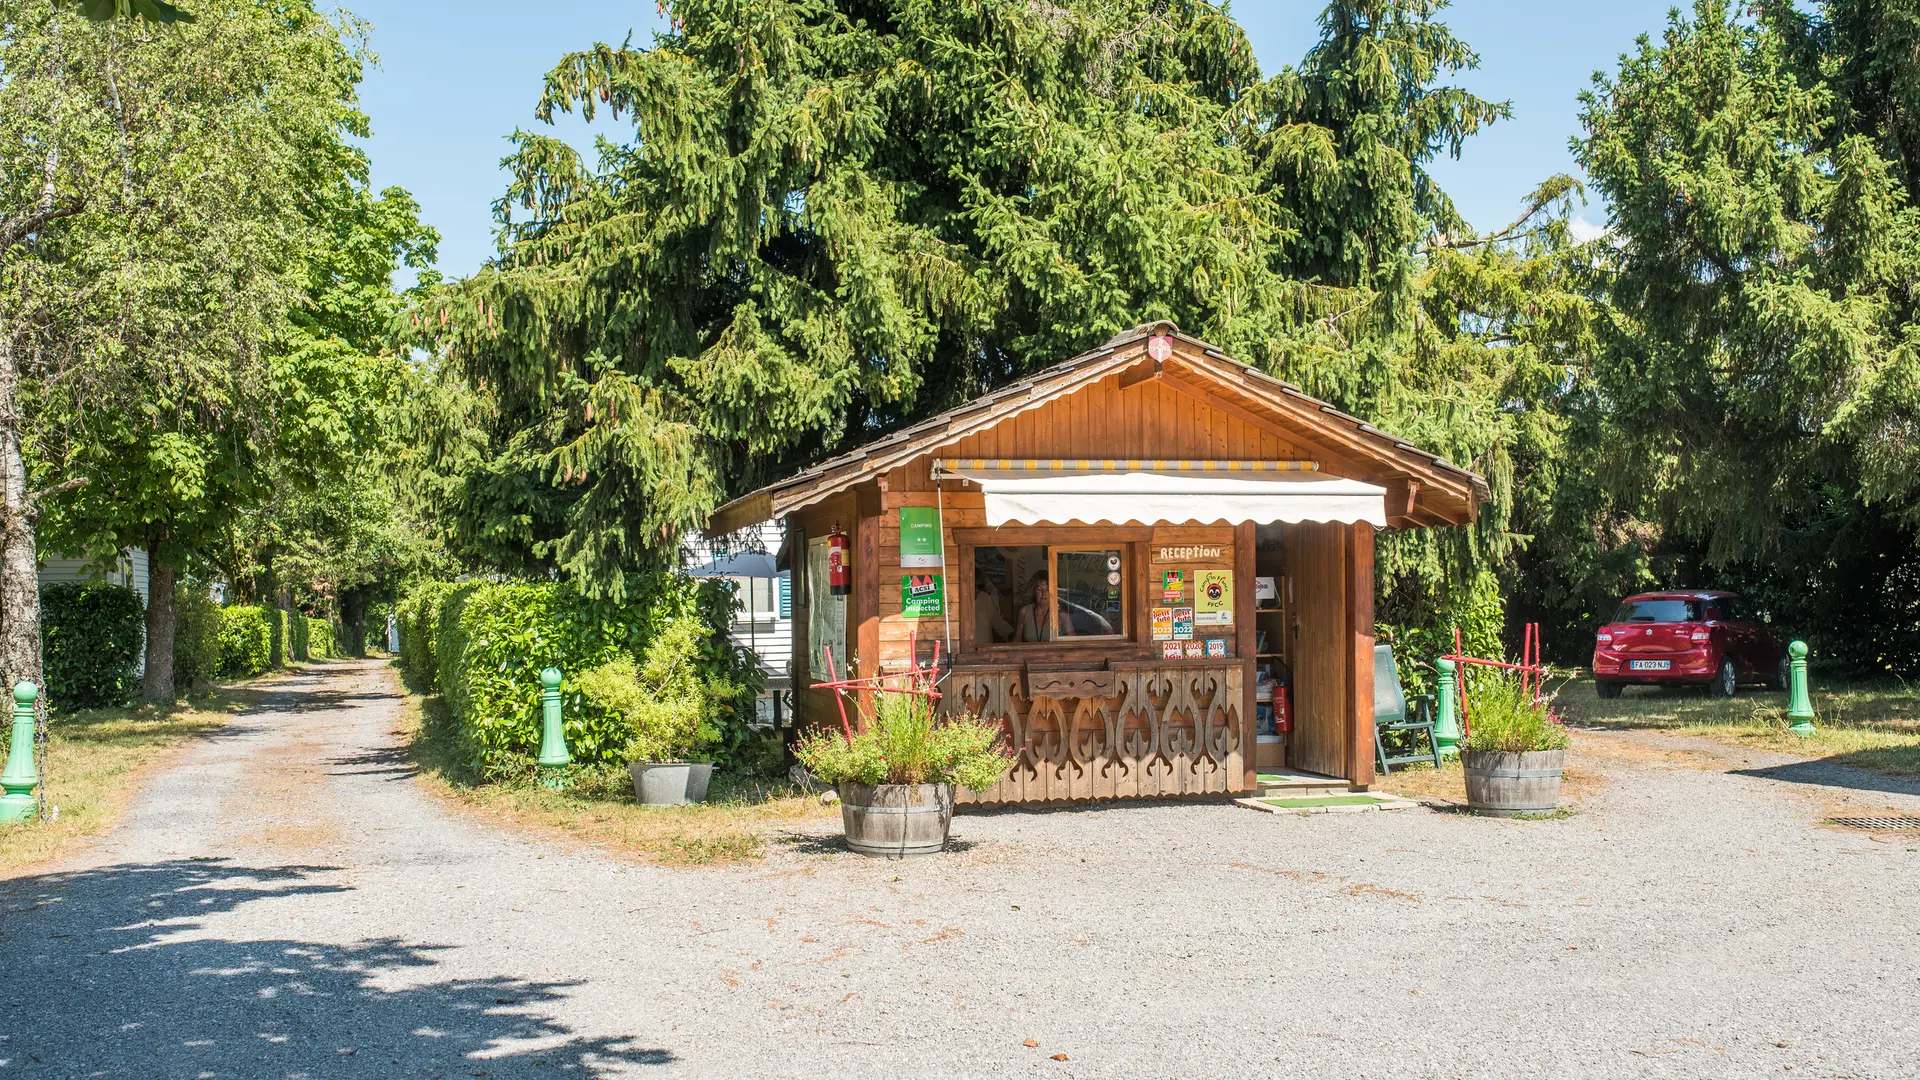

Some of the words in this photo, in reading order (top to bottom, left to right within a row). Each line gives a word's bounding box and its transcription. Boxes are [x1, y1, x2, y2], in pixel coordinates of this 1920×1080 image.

[906, 597, 940, 605] Camping
[1164, 642, 1181, 650] 2021
[1186, 642, 1203, 650] 2020
[1209, 642, 1223, 650] 2019
